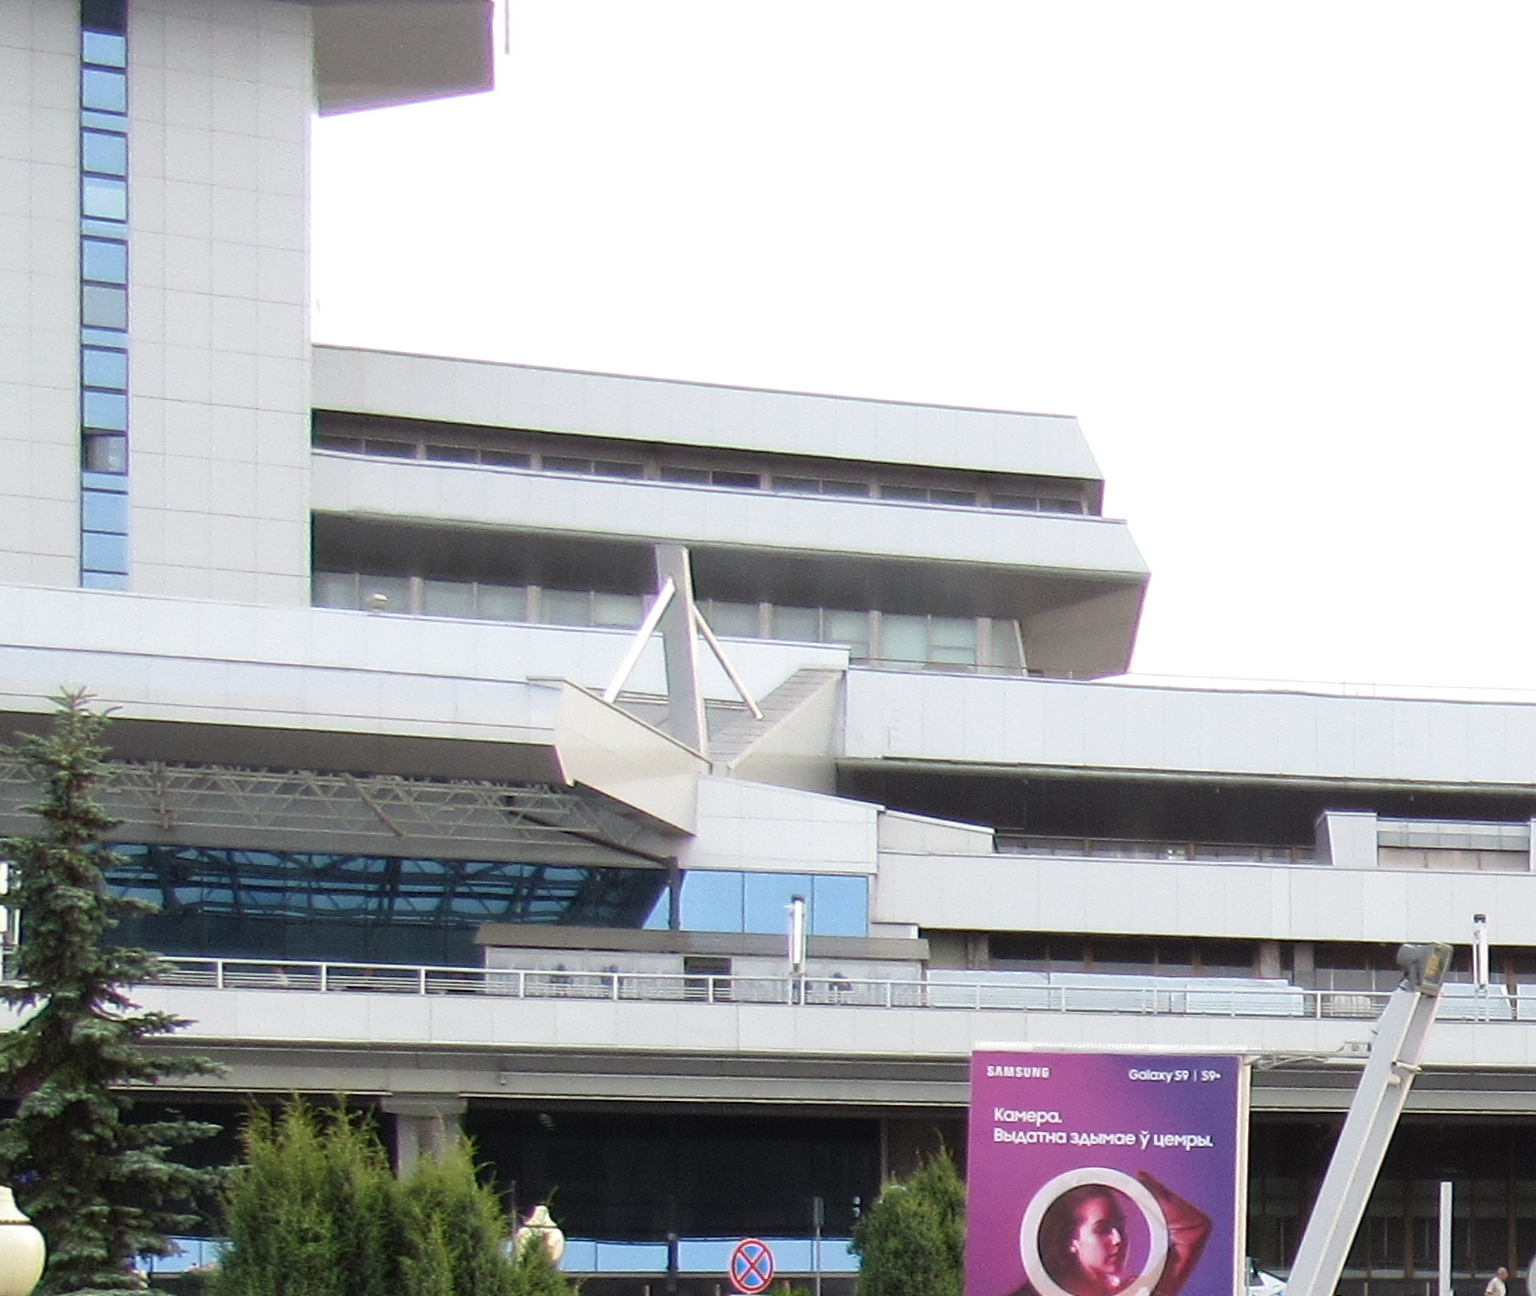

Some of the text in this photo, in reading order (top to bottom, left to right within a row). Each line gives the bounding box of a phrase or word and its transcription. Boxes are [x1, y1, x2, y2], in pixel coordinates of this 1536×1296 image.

[986, 1065, 1050, 1079] SAMSUNG
[1128, 1069, 1173, 1084] Galaxy
[1174, 1070, 1190, 1082] S9
[994, 1108, 1063, 1127] Камера.
[993, 1128, 1214, 1151] Выдатна здымае ў цемры.
